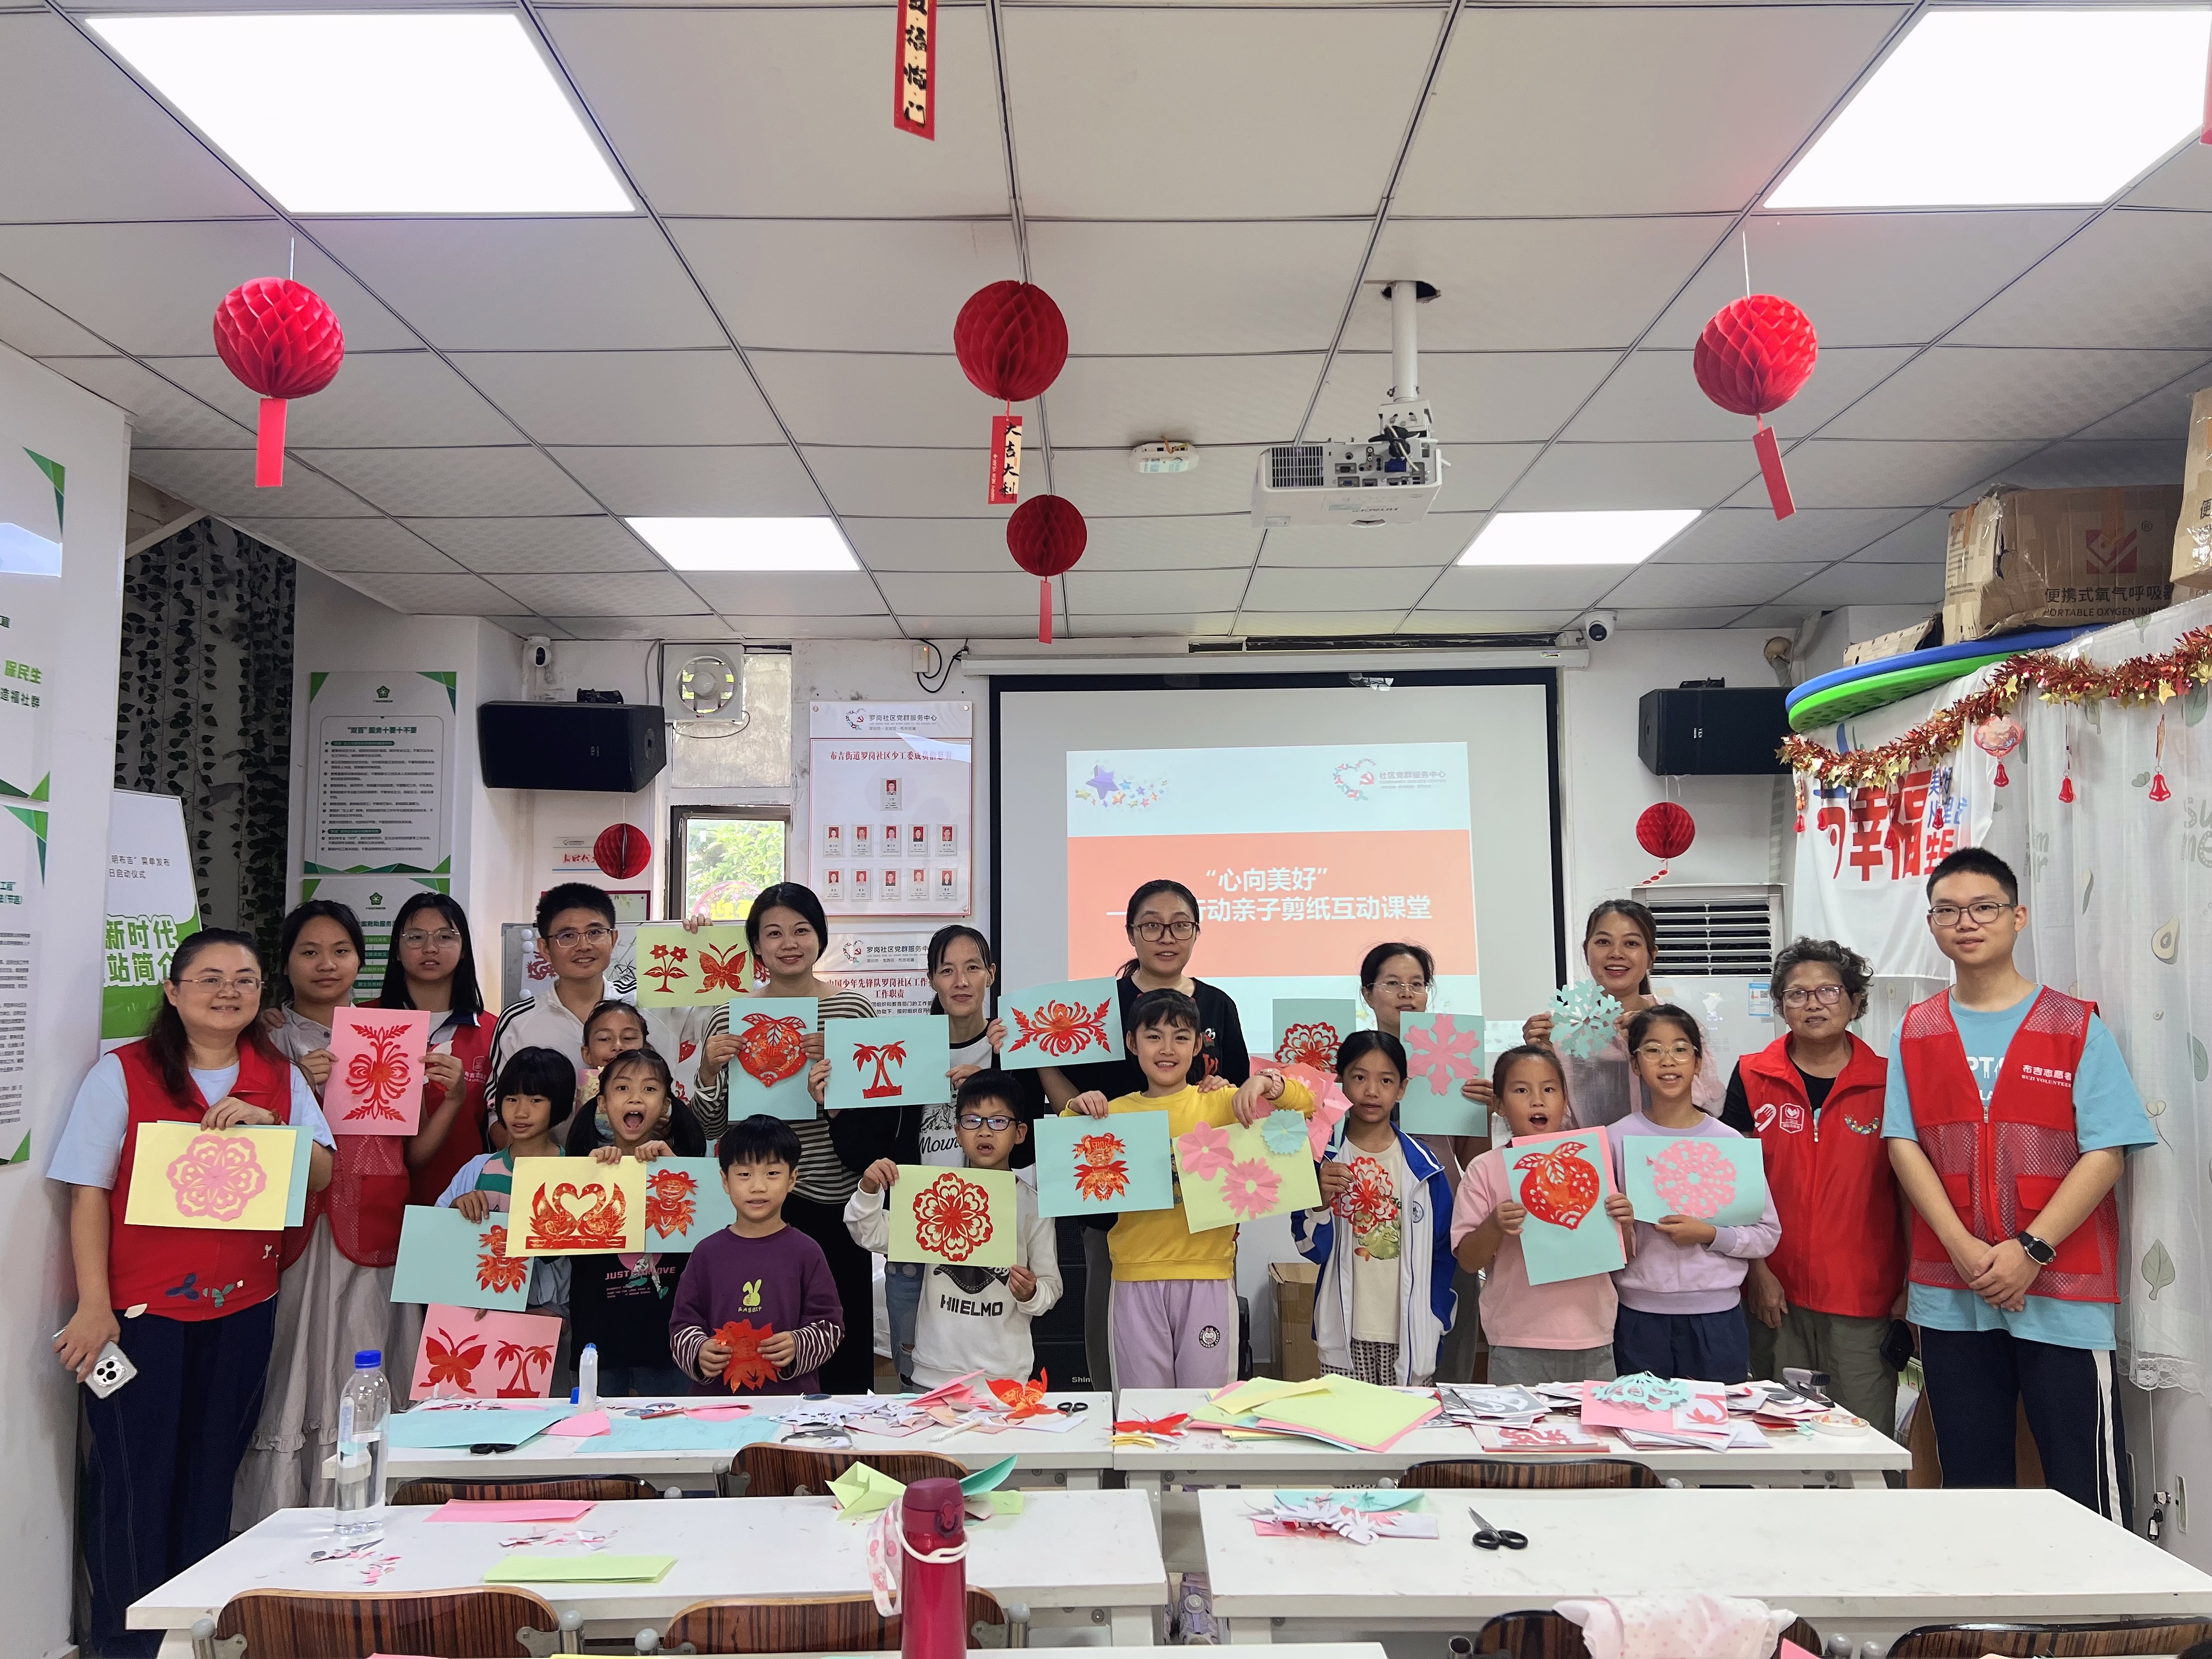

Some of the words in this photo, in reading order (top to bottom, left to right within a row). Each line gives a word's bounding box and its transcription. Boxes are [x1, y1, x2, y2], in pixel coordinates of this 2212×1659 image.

[999, 422, 1022, 500] 大吉大利
[2045, 608, 2094, 617] PORTABLE
[111, 855, 137, 864] 明布吉”
[1206, 867, 1328, 892] “心向美好”
[106, 919, 176, 950] 新时代
[104, 952, 174, 983] 站简介
[827, 978, 932, 988] 中国少年先锋队罗岗社区工作
[874, 989, 905, 999] 工作职责
[2022, 1064, 2072, 1081] 布吉志愿者
[919, 1136, 962, 1154] Moun
[605, 1270, 630, 1280] JUST
